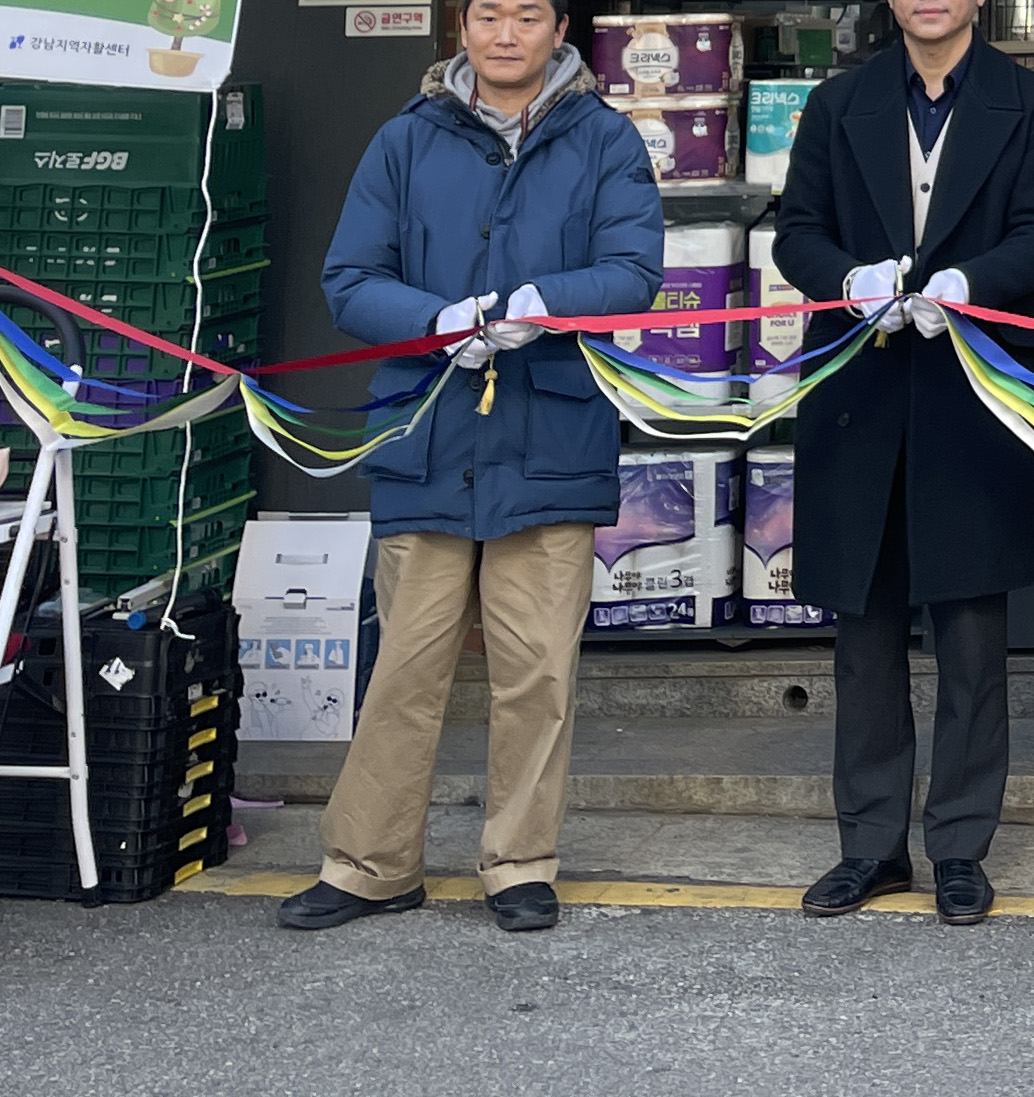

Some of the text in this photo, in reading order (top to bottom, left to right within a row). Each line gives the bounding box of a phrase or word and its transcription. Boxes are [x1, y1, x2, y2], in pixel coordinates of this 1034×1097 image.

[381, 12, 423, 25] 금연구역
[31, 37, 130, 56] 강남지역자활센터
[34, 150, 129, 171] BGF로지스
[768, 580, 791, 595] 나무
